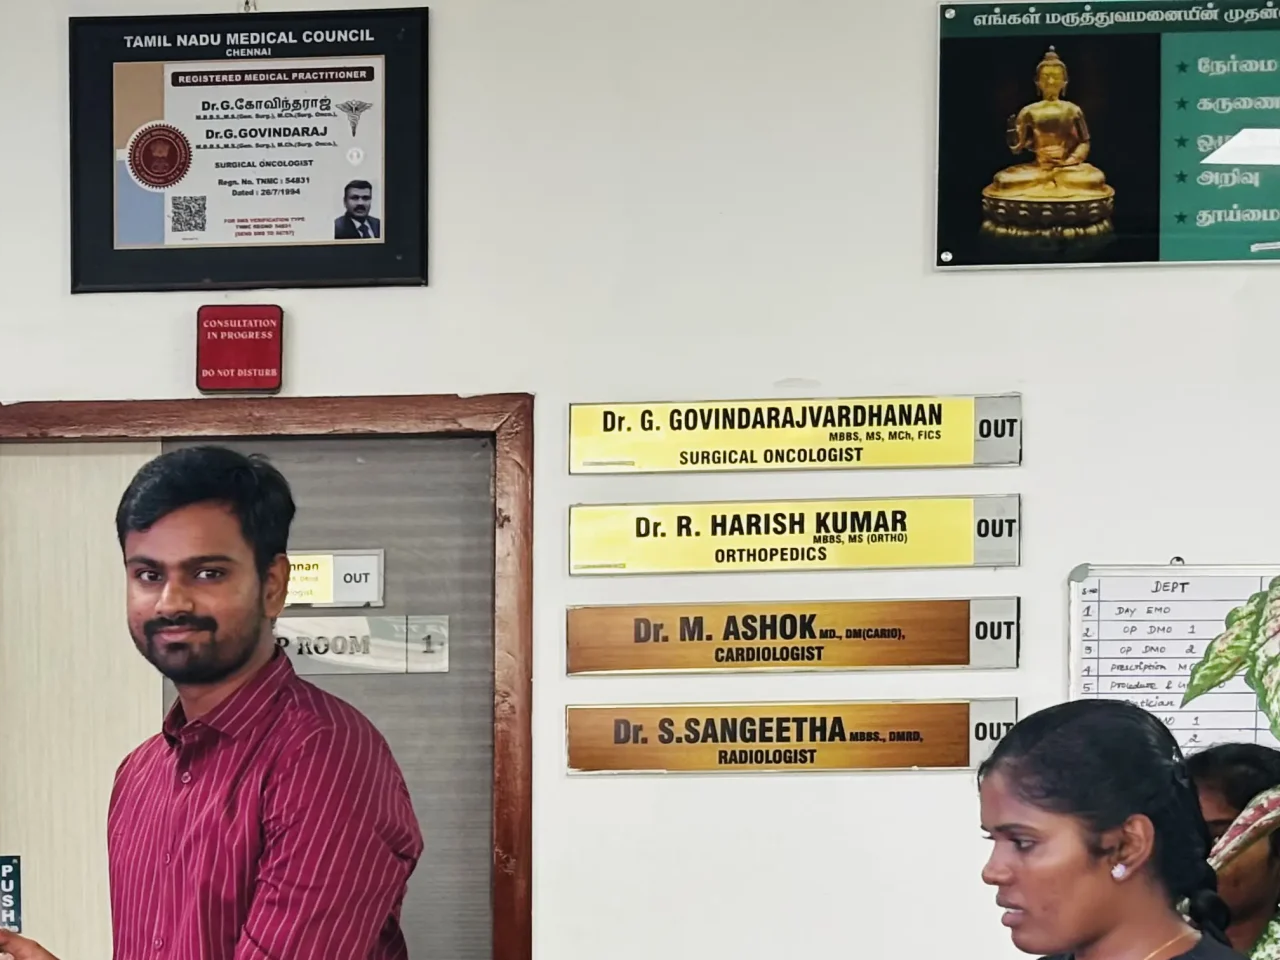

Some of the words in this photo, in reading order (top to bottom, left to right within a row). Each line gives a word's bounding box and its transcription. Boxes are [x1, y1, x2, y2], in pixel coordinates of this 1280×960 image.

[973, 8, 1040, 27] எங்கள்
[1045, 4, 1218, 26] மருத்துவமனையின்
[1224, 1, 1280, 23] முதன்
[124, 36, 172, 48] TAMIL
[176, 34, 221, 47] NADU
[226, 31, 297, 45] MEDICAL
[302, 29, 374, 43] COUNCIL
[226, 48, 271, 57] CHENNAI
[178, 73, 242, 83] REGISTERED
[244, 71, 289, 82] MEDICAL
[291, 70, 367, 81] PRACTITIONER
[259, 160, 314, 168] ONCOLOGIST
[1196, 168, 1260, 188] அறிவு
[203, 319, 277, 328] CONSULTATION
[207, 331, 218, 339] IN
[220, 330, 273, 340] PROGRESS
[202, 369, 215, 377] DO
[217, 368, 235, 377] NOT
[237, 368, 277, 377] DISTURB
[603, 410, 632, 433] Dr.
[640, 409, 661, 432] G.
[669, 403, 943, 431] GOVINDARAJVARDHANAN
[829, 432, 862, 443] MBBS,
[866, 431, 885, 442] MS,
[918, 430, 942, 440] FICS
[978, 418, 1018, 439] OUT
[679, 449, 758, 465] SURGICAL
[763, 447, 864, 464] ONCOLOGIST
[635, 516, 666, 538] Dr.
[676, 515, 700, 537] R.
[711, 513, 805, 536] HARISH
[815, 510, 908, 534] KUMAR
[976, 518, 1016, 539] OUT
[813, 534, 845, 546] MBBS,
[848, 534, 863, 544] MS
[866, 532, 908, 545] (ORTHO)
[715, 546, 827, 563] ORTHOPEDICS
[343, 572, 370, 584] OUT
[1151, 580, 1190, 593] DEPT
[1115, 607, 1137, 616] DAY
[633, 617, 669, 643] Dr.
[679, 616, 713, 641] M.
[722, 613, 818, 641] ASHOK
[975, 620, 1015, 641] OUT
[1123, 625, 1138, 634] OP
[1147, 625, 1172, 635] DMO
[296, 635, 371, 655] ROOM
[422, 634, 436, 654] 1
[714, 646, 825, 663] CARDIOLOGIST
[613, 718, 649, 745] Dr.
[658, 716, 847, 744] S.SANGEETHA
[718, 748, 817, 765] RADIOLOGIST
[1, 864, 15, 922] PUSH
